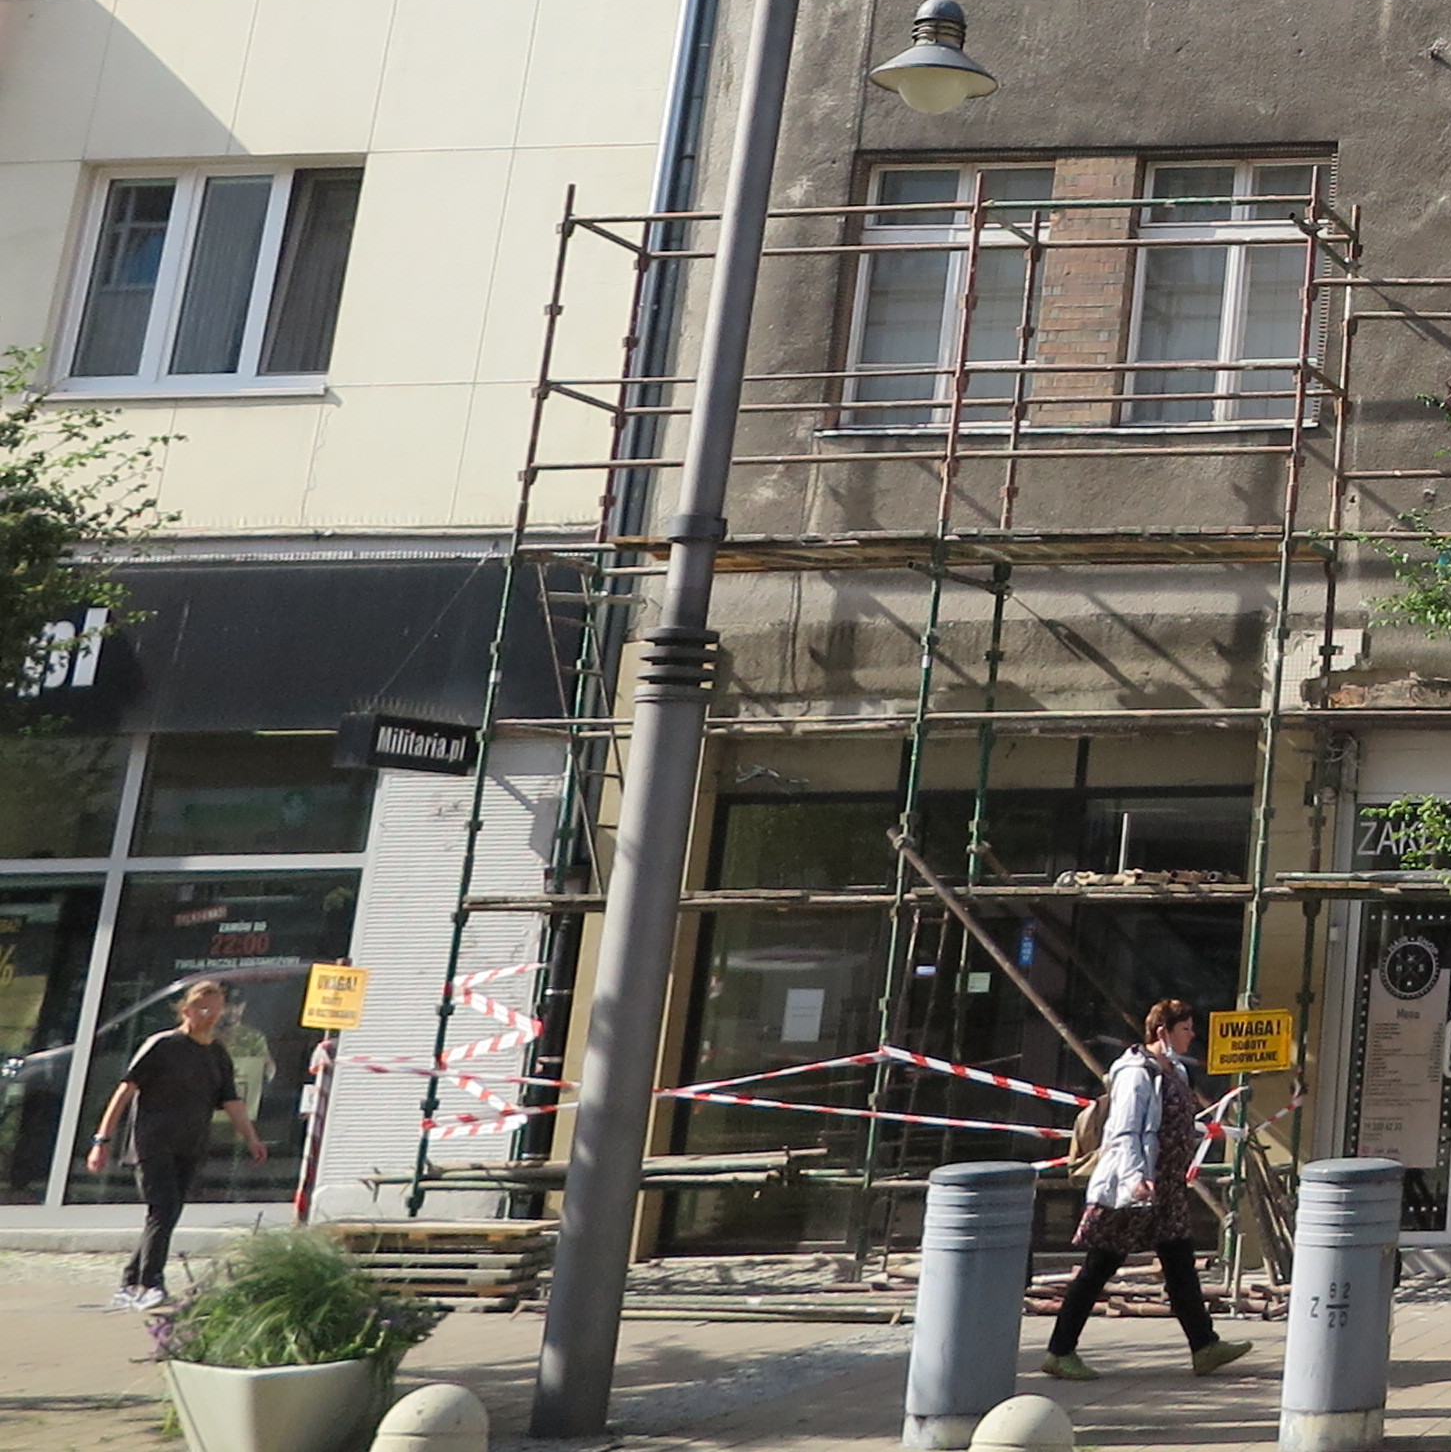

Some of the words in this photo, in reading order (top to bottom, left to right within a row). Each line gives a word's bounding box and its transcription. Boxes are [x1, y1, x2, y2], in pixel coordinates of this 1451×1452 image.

[376, 726, 467, 763] Militaria.pl
[1232, 1039, 1267, 1050] ROBOTY
[1220, 1051, 1277, 1064] BUDOWLANE
[1310, 1296, 1320, 1318] Z
